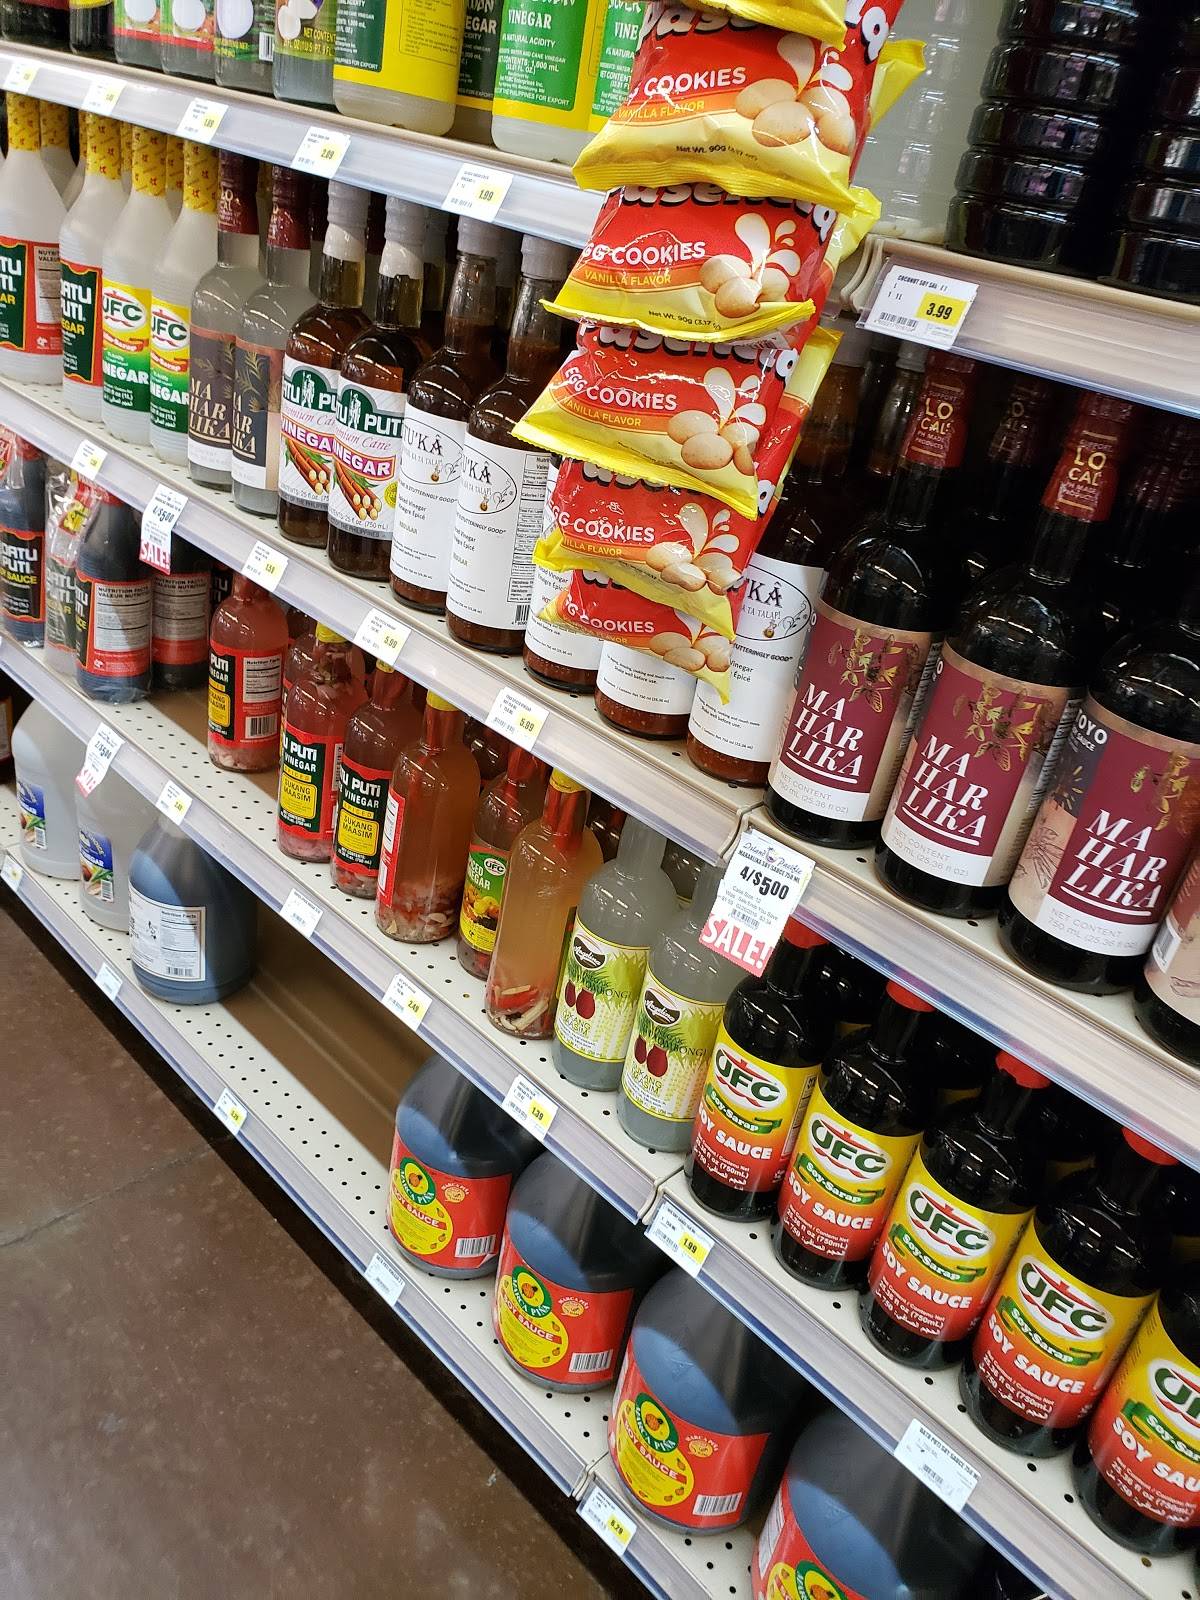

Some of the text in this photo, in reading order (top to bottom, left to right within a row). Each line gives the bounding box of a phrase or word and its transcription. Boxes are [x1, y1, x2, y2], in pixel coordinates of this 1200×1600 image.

[508, 9, 552, 30] VINEGAR
[644, 67, 746, 97] COOKIES
[619, 100, 704, 118] VANILLA FLAVOR
[611, 242, 706, 265] COOKIES
[584, 270, 672, 287] VANILLA FLAVOR
[926, 302, 953, 320] 3.99
[103, 361, 149, 384] NEGAR
[151, 381, 189, 405] NEGAR
[565, 366, 678, 411] EGG COOKIES
[562, 397, 642, 427] VANILLA FLAVOR
[925, 397, 953, 420] LO
[190, 413, 230, 439] LIKA
[364, 413, 401, 437] PUT
[362, 437, 391, 451] Cane
[1073, 447, 1106, 470] LO
[409, 500, 427, 512] Vinegar
[460, 532, 476, 543] Vinegar
[574, 518, 655, 542] COOKIES
[588, 545, 623, 557] FLAVOR
[7, 572, 38, 585] SAUCE
[384, 635, 398, 649] 5.99
[210, 652, 229, 673] PUTI
[730, 659, 754, 673] Vinegar
[801, 682, 845, 721] MA
[520, 718, 535, 732] 5.99
[794, 707, 864, 751] HAR
[290, 743, 318, 762] PUTI
[1077, 732, 1096, 751] SAUCE
[285, 754, 317, 773] VINEGAR
[788, 731, 863, 777] LIKA
[921, 735, 971, 778] MA
[284, 786, 311, 803] MAASIM
[285, 777, 311, 795] SUKANG
[352, 777, 381, 798] PUTI
[794, 779, 832, 799] CONTENT
[913, 760, 989, 811] HAR
[344, 790, 379, 809] VINEGAR
[903, 785, 987, 838] LIKA
[343, 823, 373, 840] MAASIM
[344, 815, 373, 832] SUKANG
[1085, 808, 1153, 852] MA
[908, 836, 949, 861] CONTENT
[1075, 836, 1168, 884] HAR
[486, 861, 505, 873] UFC
[770, 864, 785, 876] SAUCE
[784, 871, 794, 880] 750
[732, 885, 743, 894] Case
[1063, 863, 1162, 909] LIKA
[766, 911, 778, 921] Save
[1073, 918, 1123, 938] CONTENT
[702, 915, 774, 969] SALE!
[574, 945, 602, 967] Angelina
[645, 1000, 676, 1022] Angelina
[716, 1049, 781, 1102] UFC
[531, 1107, 544, 1121] 1.39
[710, 1090, 759, 1131] Soy-Sarap
[699, 1103, 773, 1160] SOY SAUCE
[811, 1119, 887, 1173] UFC
[720, 1161, 749, 1178] (750mL)
[806, 1161, 861, 1203] Soy-Sarap
[789, 1171, 874, 1229] SOY SAUCE
[406, 1203, 440, 1228] SAUCE
[910, 1190, 989, 1250] UFC
[684, 1238, 697, 1254] 1.99
[817, 1232, 848, 1249] (750mL)
[903, 1233, 960, 1281] Soy-Sarap
[882, 1241, 972, 1309] SOY SAUCE
[1021, 1262, 1107, 1332] UFC
[503, 1293, 553, 1342] SOY SAUCE
[911, 1308, 944, 1328] (750mL)
[1011, 1308, 1073, 1363] Soy-Sarap
[988, 1313, 1086, 1394] SOY SAUCE
[1015, 1388, 1053, 1413] (750mL)
[1146, 1413, 1200, 1463] Soy-Sar
[639, 1446, 678, 1480] SAUCE
[1112, 1415, 1200, 1492] SOY SAU
